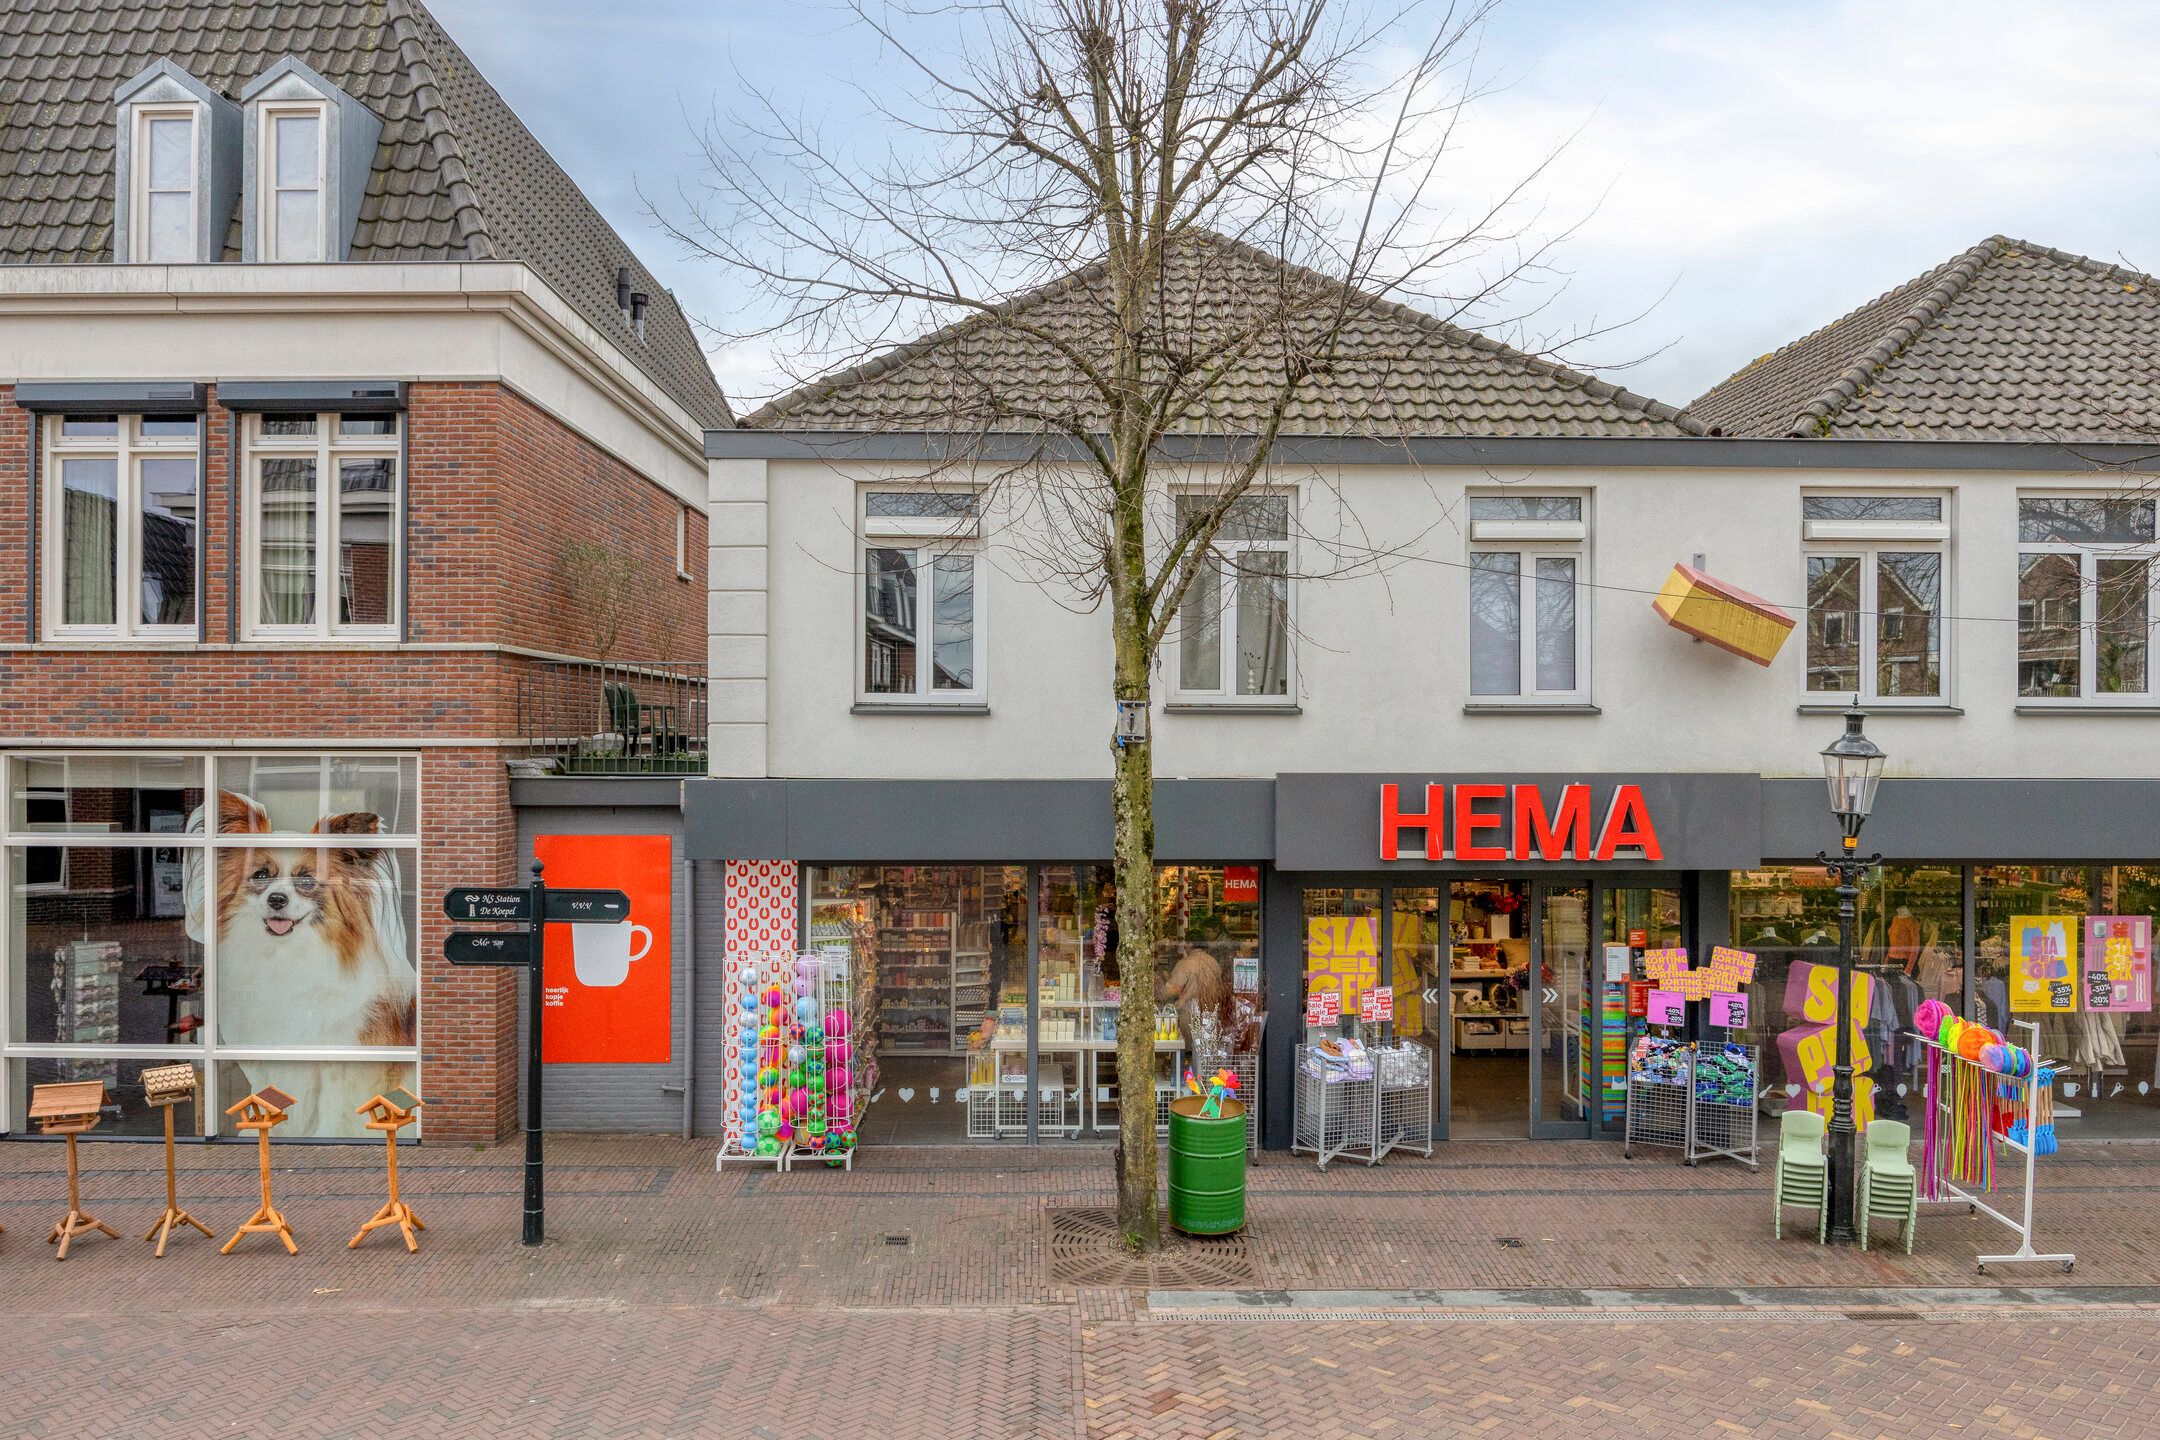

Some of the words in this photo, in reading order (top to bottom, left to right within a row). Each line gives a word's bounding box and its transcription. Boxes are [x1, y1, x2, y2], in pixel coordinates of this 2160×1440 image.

[1380, 783, 1664, 861] HEMA
[1225, 879, 1257, 889] HEMA
[482, 894, 494, 904] NS
[495, 895, 521, 903] Station
[480, 906, 492, 915] De
[492, 906, 517, 917] Koepel
[1308, 917, 1377, 956] STA
[2031, 936, 2058, 955] STA
[2105, 937, 2133, 956] STA
[1644, 949, 1664, 957] PAK
[1666, 949, 1677, 957] JE
[1713, 946, 1742, 958] STAPEL
[1745, 953, 1756, 961] JE
[1308, 957, 1377, 973] PEL
[1645, 956, 1688, 965] KORTING
[1711, 954, 1755, 969] KORTING
[1646, 971, 1689, 979] KORTING
[1659, 978, 1702, 986] KORTING
[2054, 985, 2072, 994] -35%
[2092, 984, 2111, 993] -30%
[1804, 965, 1869, 1029] SA
